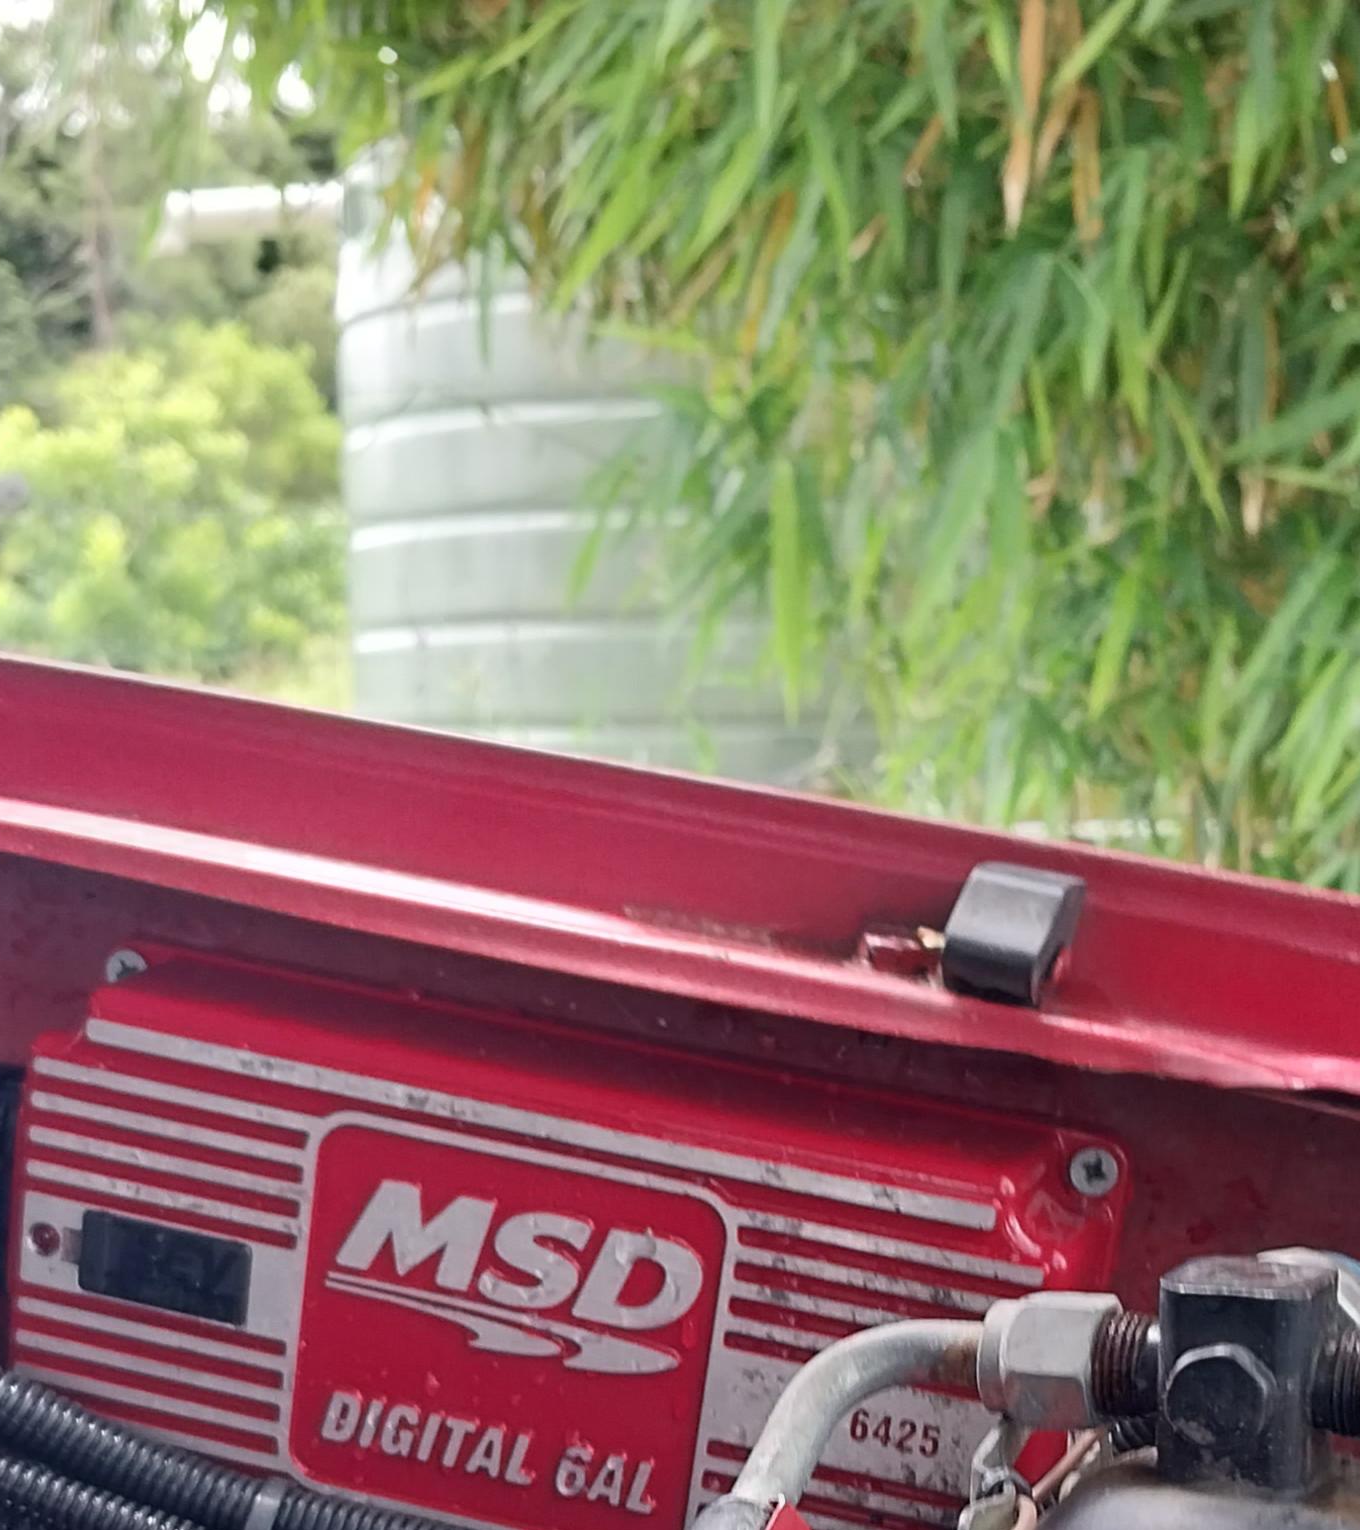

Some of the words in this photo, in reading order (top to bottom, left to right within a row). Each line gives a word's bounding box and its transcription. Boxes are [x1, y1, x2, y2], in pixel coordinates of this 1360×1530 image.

[336, 1180, 703, 1330] MSD
[320, 1390, 536, 1486] DIGITAL
[555, 1444, 656, 1514] 6AL
[849, 1407, 941, 1458] 6425
